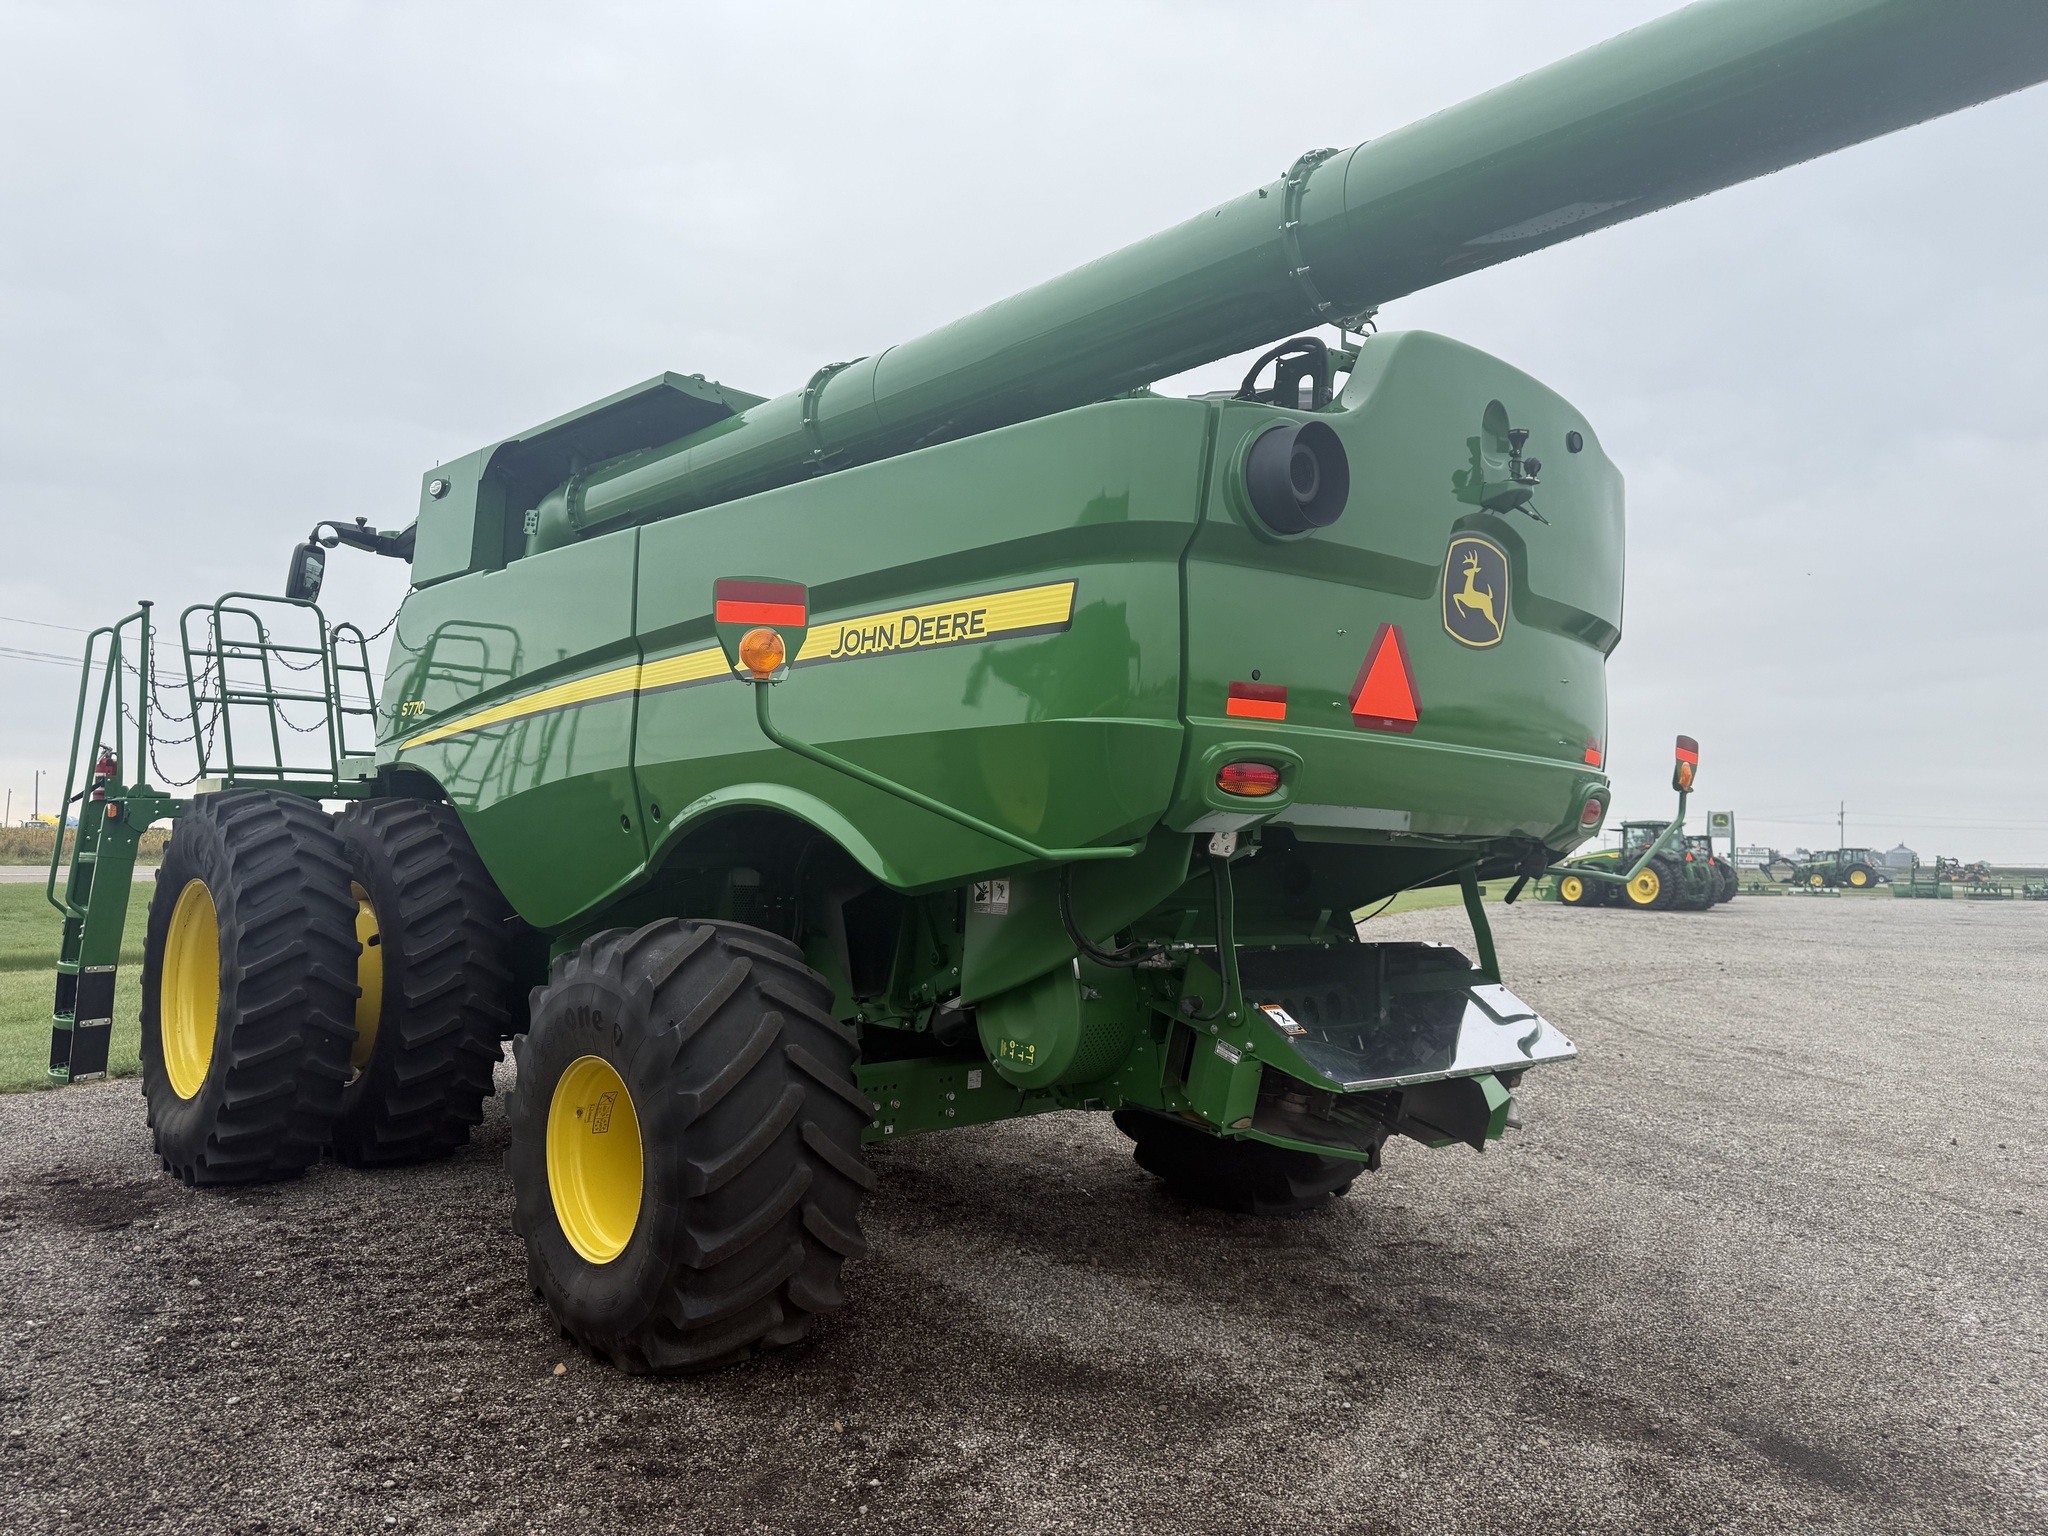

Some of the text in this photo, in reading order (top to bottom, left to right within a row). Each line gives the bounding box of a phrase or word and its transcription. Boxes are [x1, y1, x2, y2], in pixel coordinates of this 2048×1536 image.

[830, 608, 987, 656] JOHN DEERE
[401, 700, 426, 717] S770
